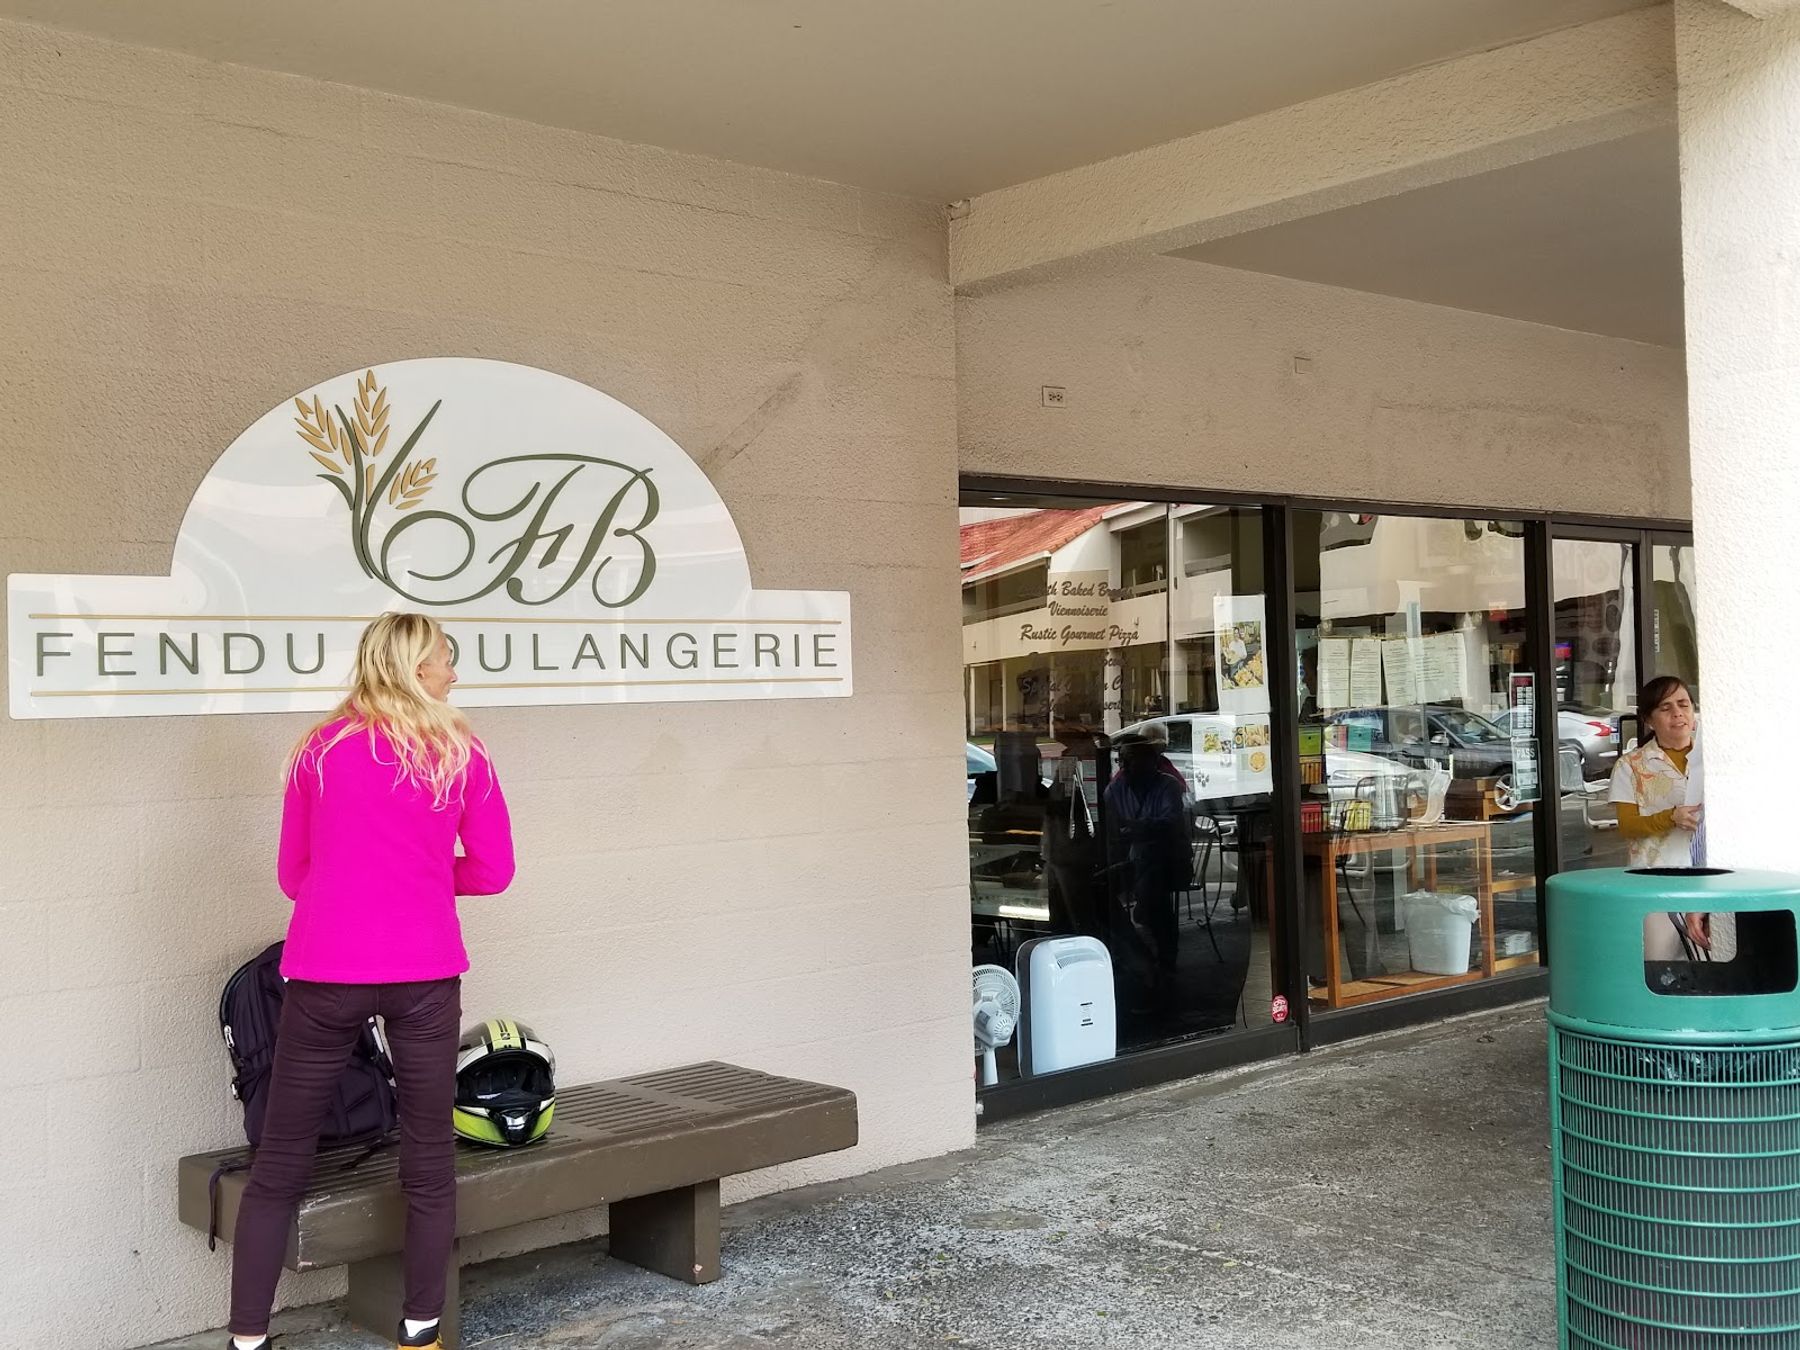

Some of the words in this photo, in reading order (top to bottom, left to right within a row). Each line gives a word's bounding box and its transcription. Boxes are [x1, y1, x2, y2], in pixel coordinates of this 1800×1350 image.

[380, 453, 660, 608] FB
[1061, 580, 1096, 597] Baked
[1048, 600, 1108, 616] Viennoiserie
[1020, 623, 1057, 640] Rustic
[1060, 625, 1106, 646] Gourmet
[1109, 624, 1140, 645] Pizza
[36, 632, 324, 676] FENDU
[445, 632, 838, 673] ULANGERIE
[1516, 747, 1536, 758] PASS
